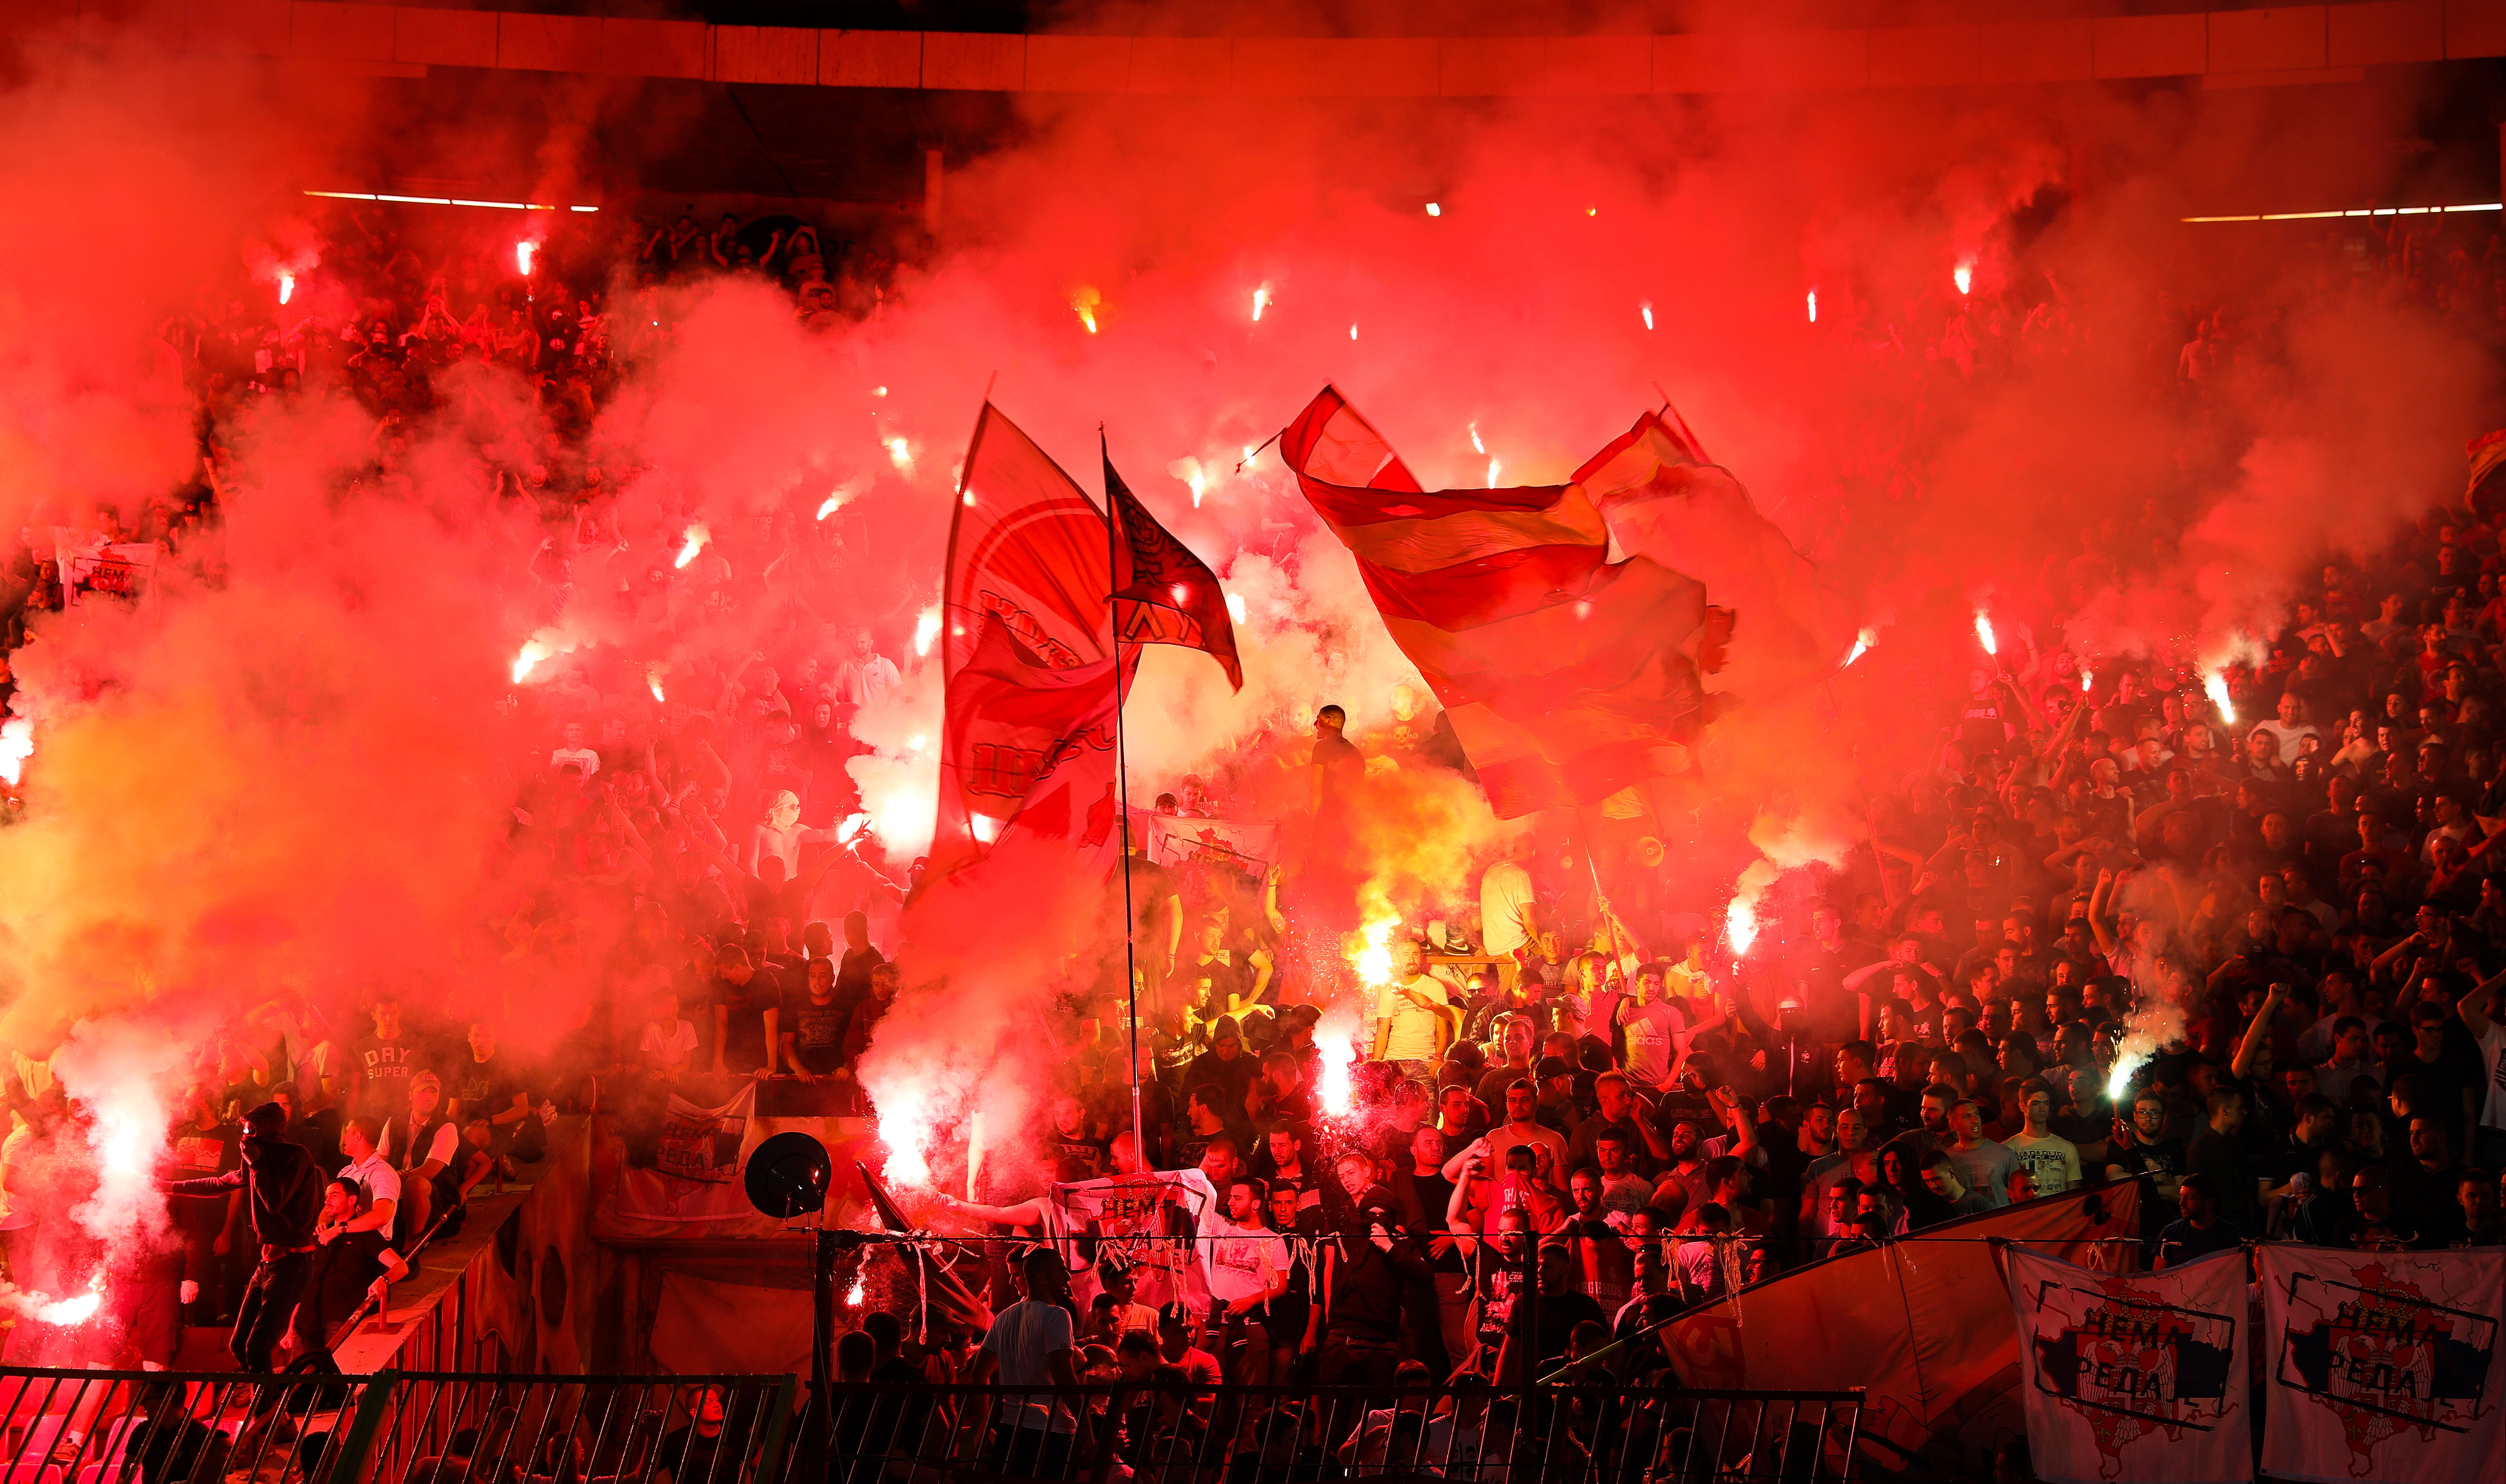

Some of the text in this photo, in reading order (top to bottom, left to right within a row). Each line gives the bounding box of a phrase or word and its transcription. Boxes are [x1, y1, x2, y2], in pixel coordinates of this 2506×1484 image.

[364, 1047, 411, 1067] DRY
[367, 1066, 408, 1080] SUPER
[2084, 1309, 2179, 1350] НЕМА
[2337, 1303, 2437, 1347] НЕМА
